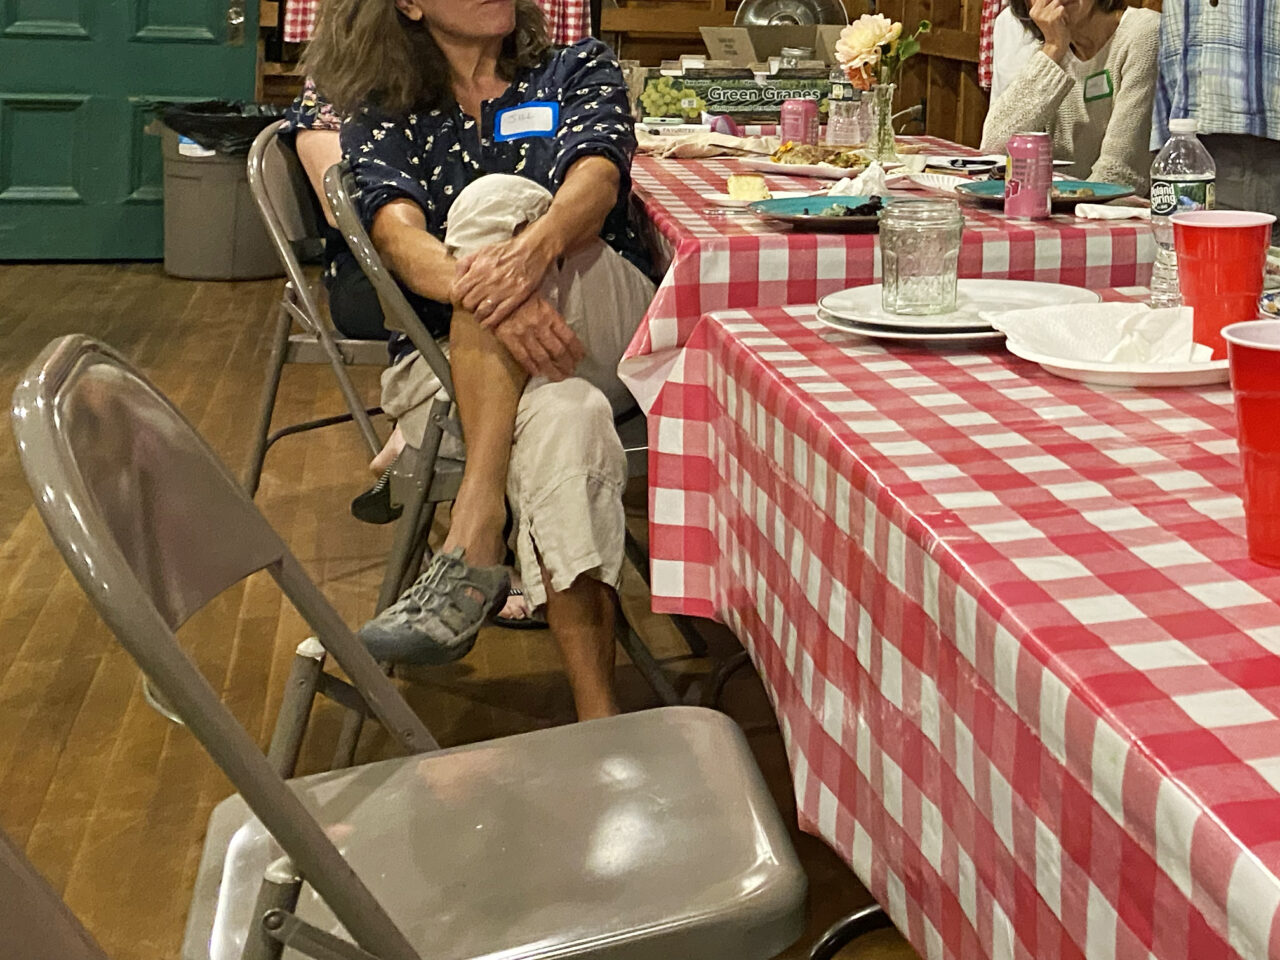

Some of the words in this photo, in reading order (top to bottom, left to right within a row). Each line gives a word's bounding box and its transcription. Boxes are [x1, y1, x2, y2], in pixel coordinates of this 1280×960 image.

[708, 87, 758, 101] Green
[761, 87, 820, 102] Grapes
[1151, 183, 1175, 197] Poland
[1151, 195, 1177, 209] Spring
